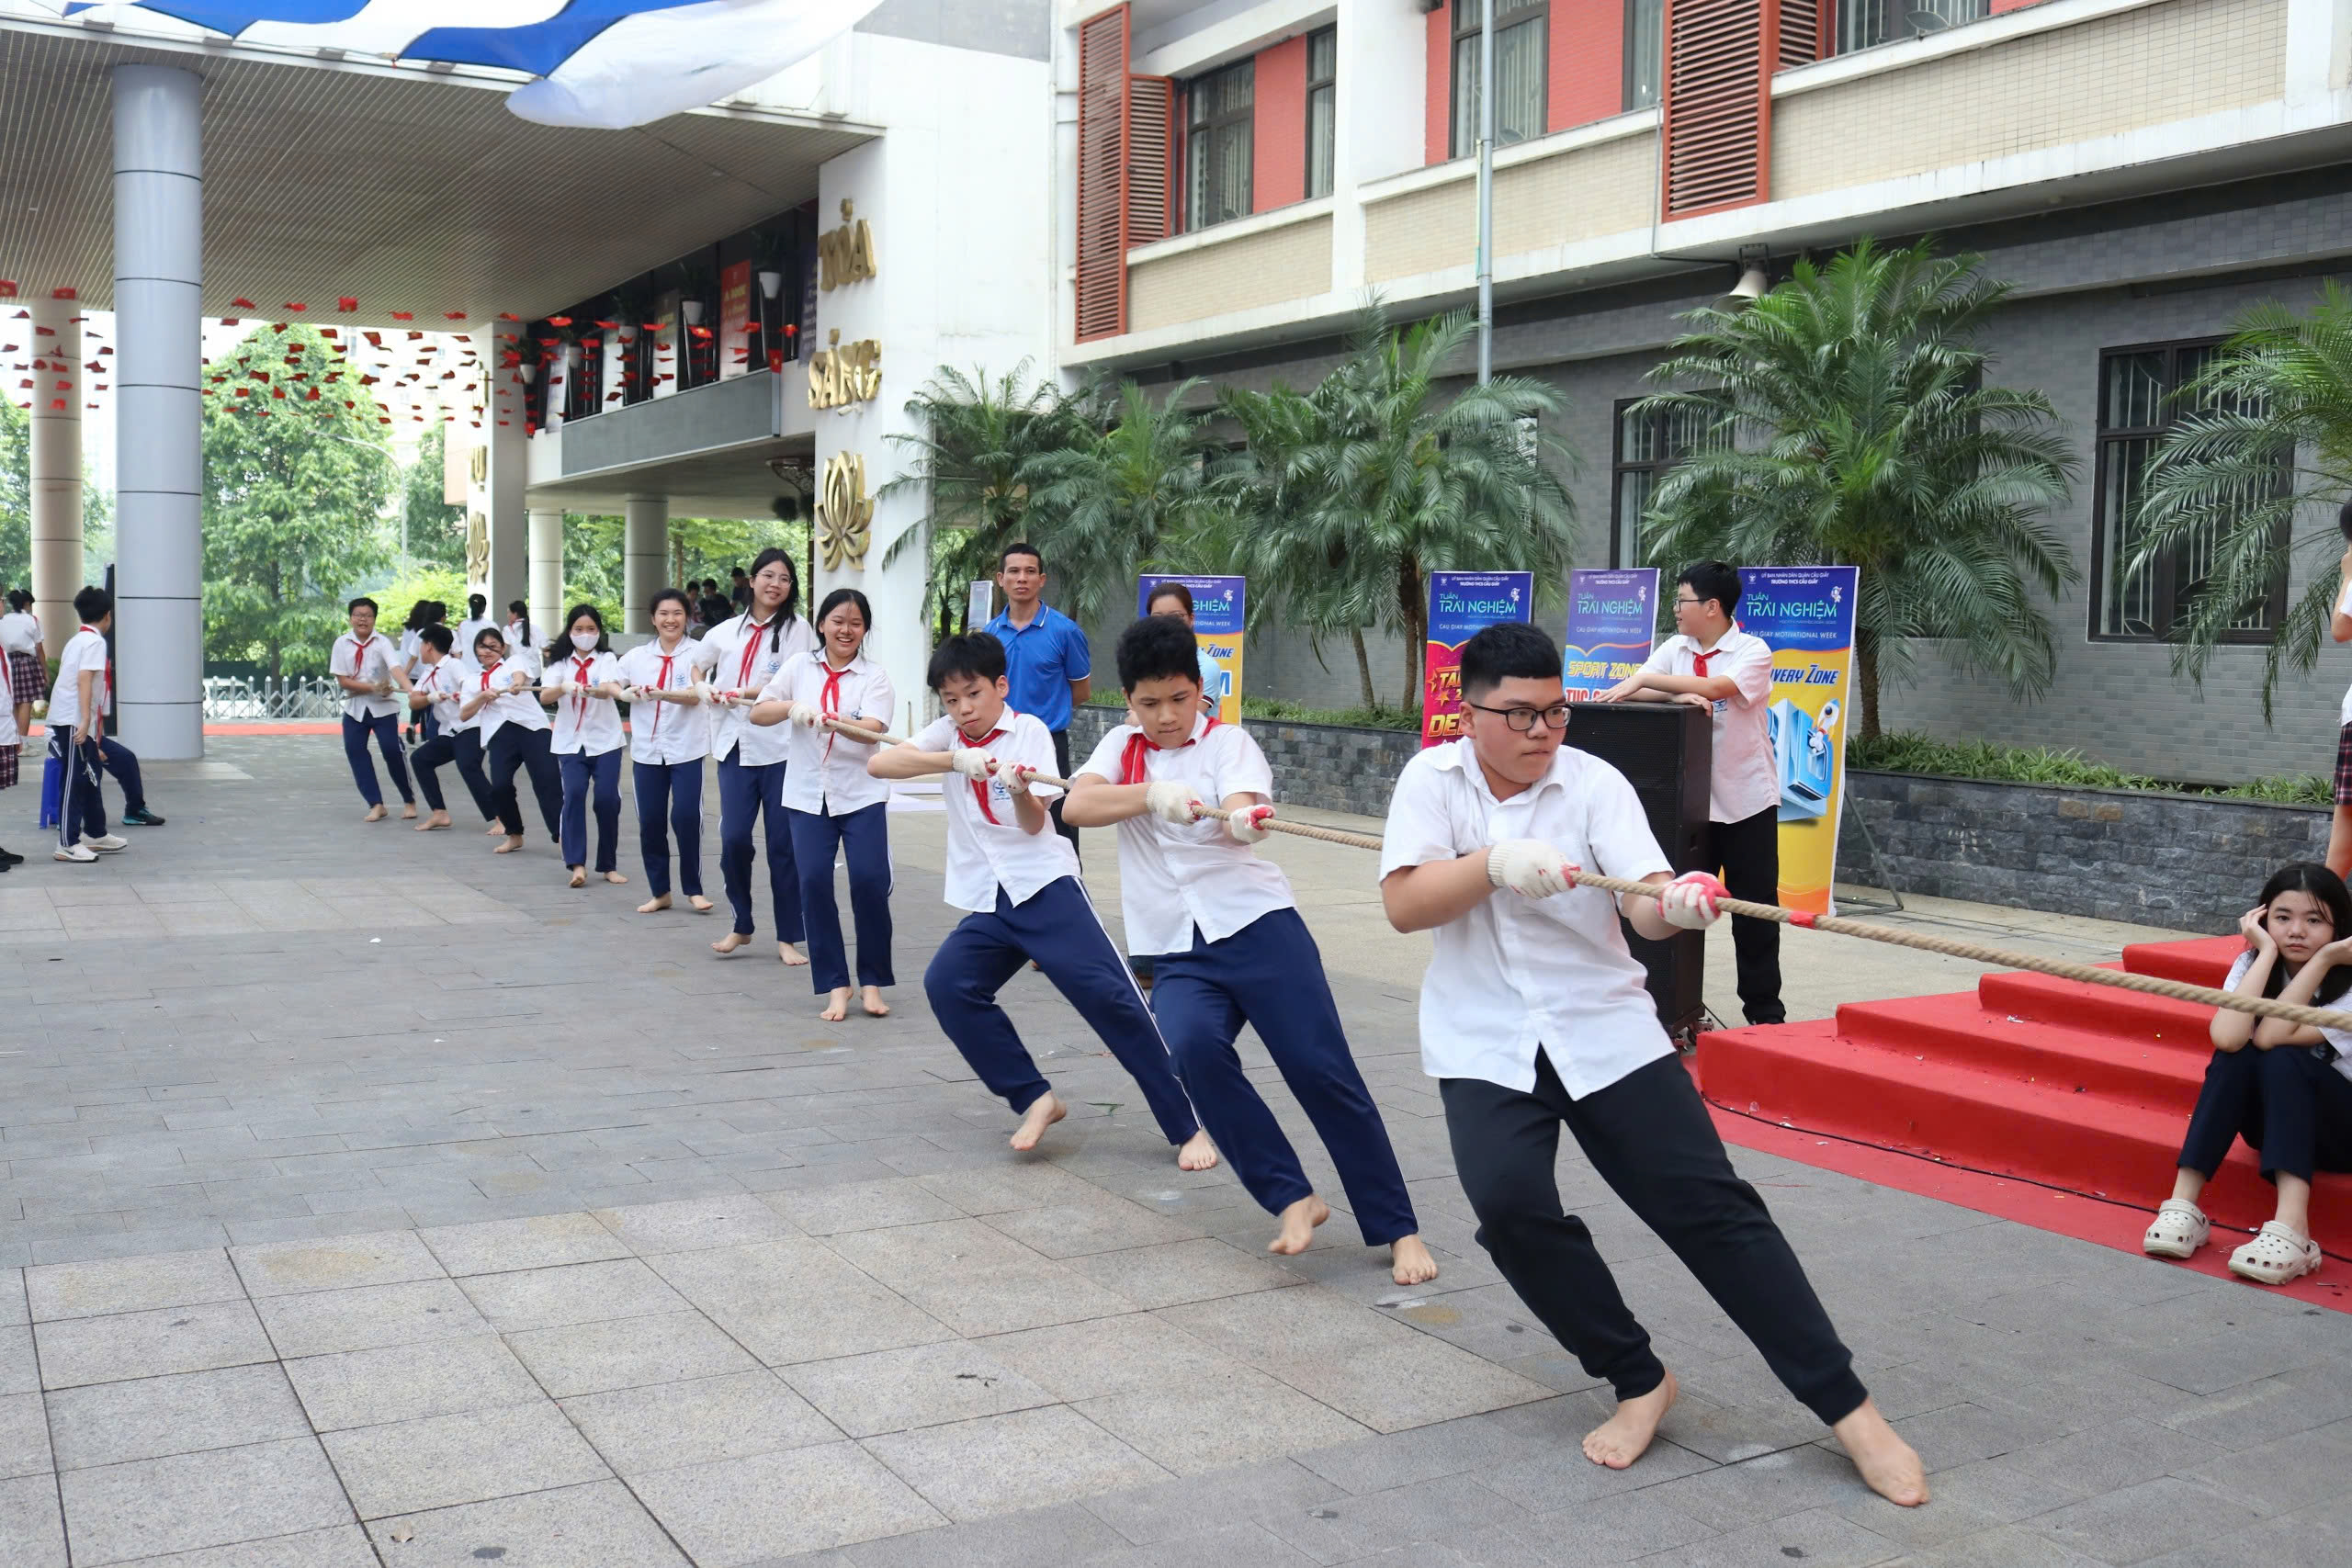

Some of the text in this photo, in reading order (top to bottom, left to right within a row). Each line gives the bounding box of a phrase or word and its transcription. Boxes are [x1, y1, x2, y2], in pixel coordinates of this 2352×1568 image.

[808, 328, 882, 410] SÁNG
[1193, 599, 1230, 613] GHIỆM
[1468, 599, 1516, 615] NGHIỆM
[1601, 599, 1643, 617] NGHIỆM
[1780, 600, 1838, 619] NGHIỆM
[1567, 661, 1609, 678] SPORT
[1804, 664, 1839, 683] ZONE
